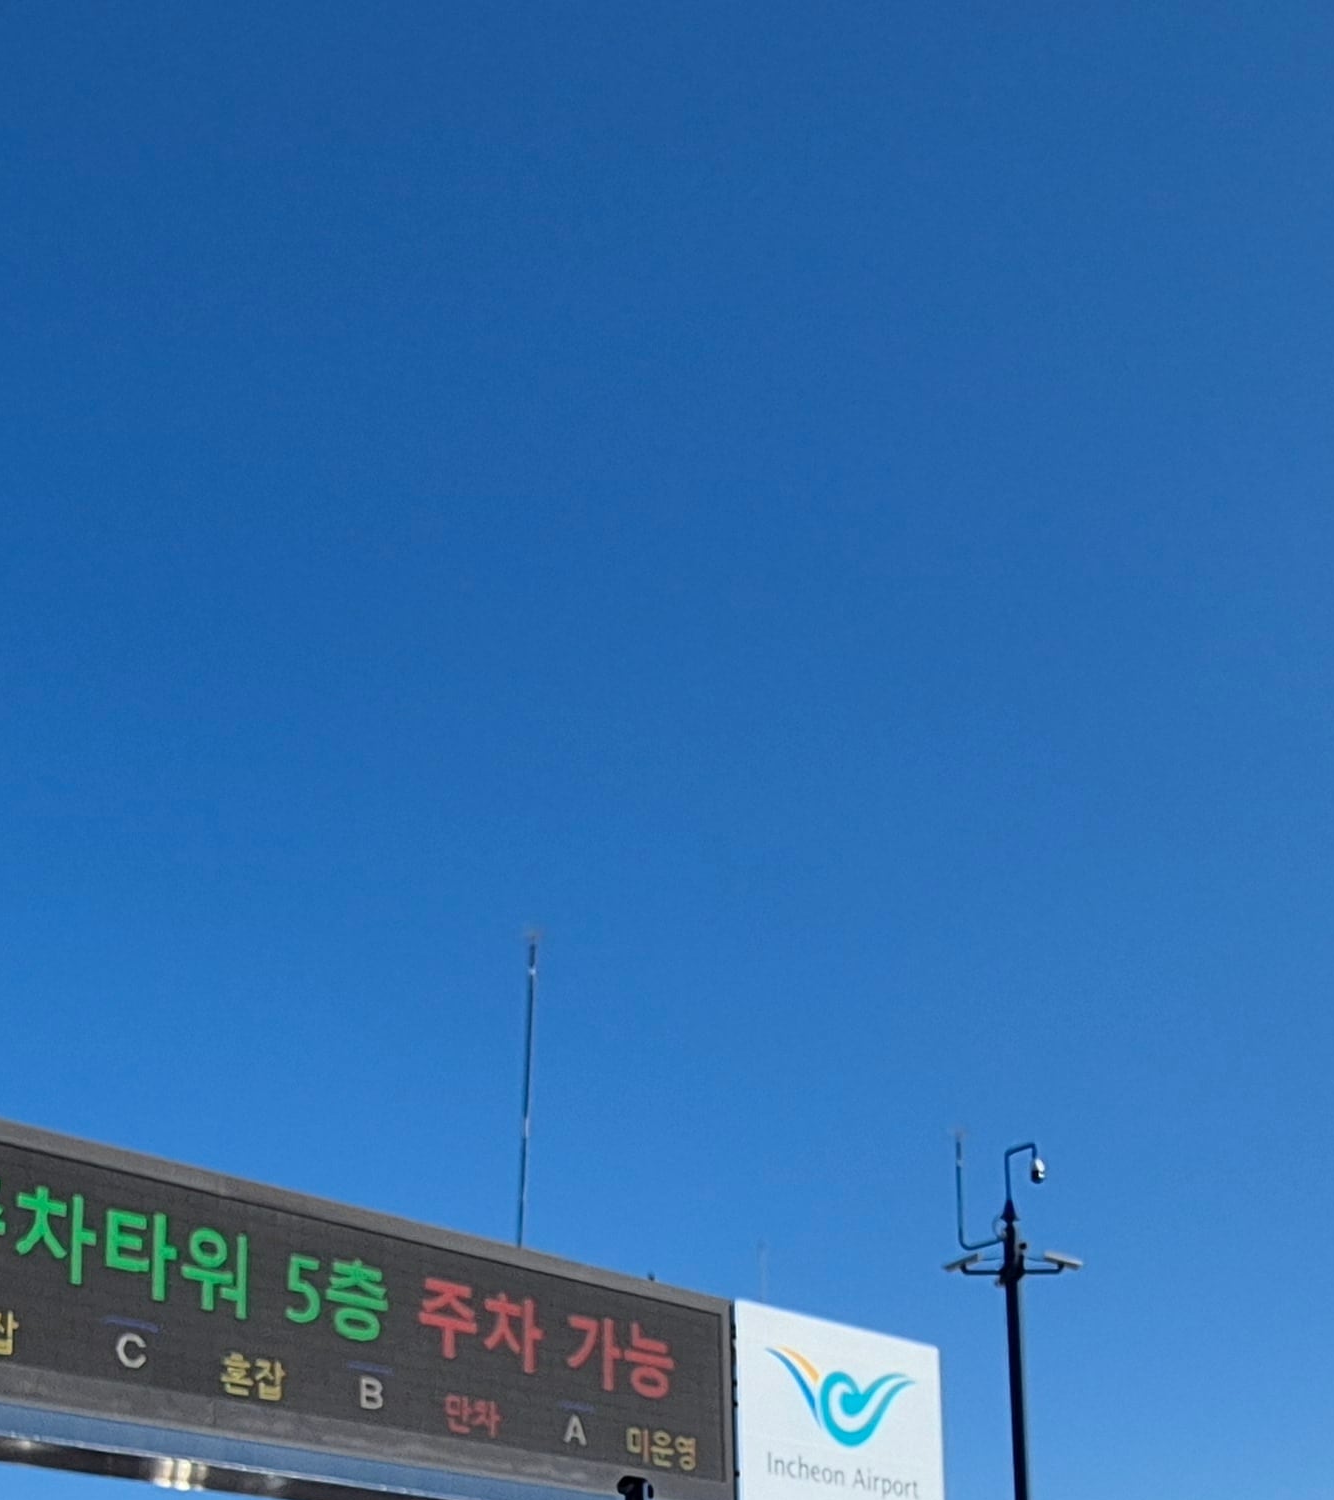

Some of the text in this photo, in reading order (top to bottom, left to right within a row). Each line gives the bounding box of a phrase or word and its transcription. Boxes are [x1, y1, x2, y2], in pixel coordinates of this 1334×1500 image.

[285, 1254, 389, 1343] 5층
[418, 1277, 544, 1374] 주차
[568, 1314, 676, 1399] 가능
[116, 1333, 147, 1369] C
[219, 1352, 285, 1401] 혼잡
[359, 1377, 384, 1410] B
[444, 1393, 504, 1438] 만차
[564, 1415, 588, 1447] A
[626, 1427, 697, 1471] 미운영
[767, 1452, 919, 1500] Incheon Airport
